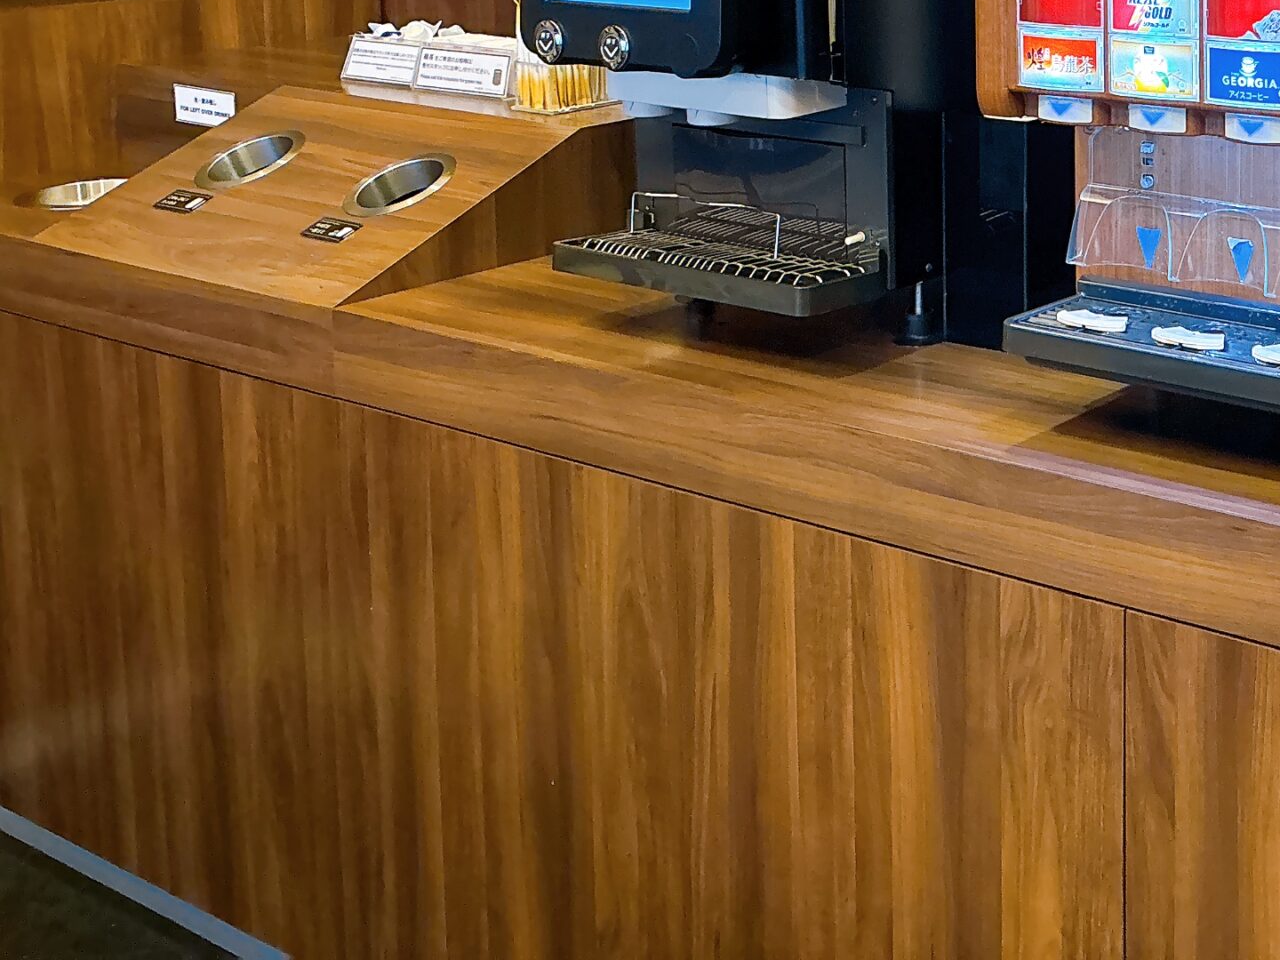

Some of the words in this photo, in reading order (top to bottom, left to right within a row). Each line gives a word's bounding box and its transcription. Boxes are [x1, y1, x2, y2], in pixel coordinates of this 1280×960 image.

[1144, 6, 1173, 20] GOLD
[1221, 75, 1279, 89] GEORGIA
[1228, 90, 1270, 101] アイスコーヒー
